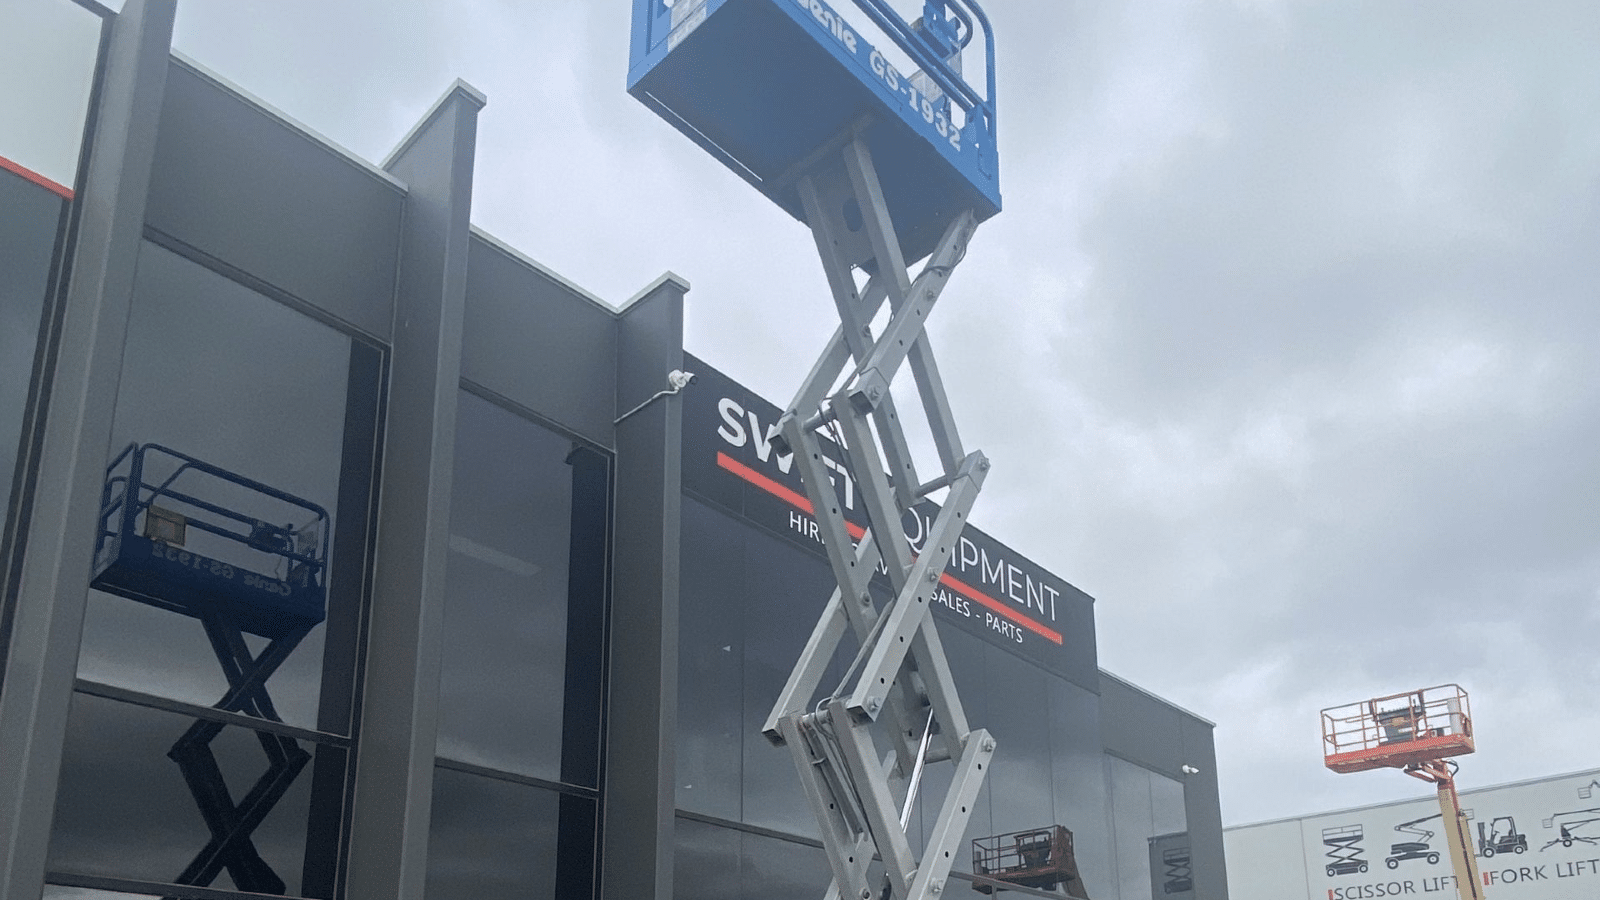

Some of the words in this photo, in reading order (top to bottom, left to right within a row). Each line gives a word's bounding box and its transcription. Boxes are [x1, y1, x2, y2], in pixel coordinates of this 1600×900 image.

[869, 50, 961, 152] GS-1932
[717, 397, 857, 510] SWT
[903, 507, 1060, 621] QIPMENT
[789, 511, 826, 545] HIR
[985, 612, 1023, 643] PARTS
[1334, 880, 1416, 900] SCISSOR
[1490, 865, 1548, 885] FORK
